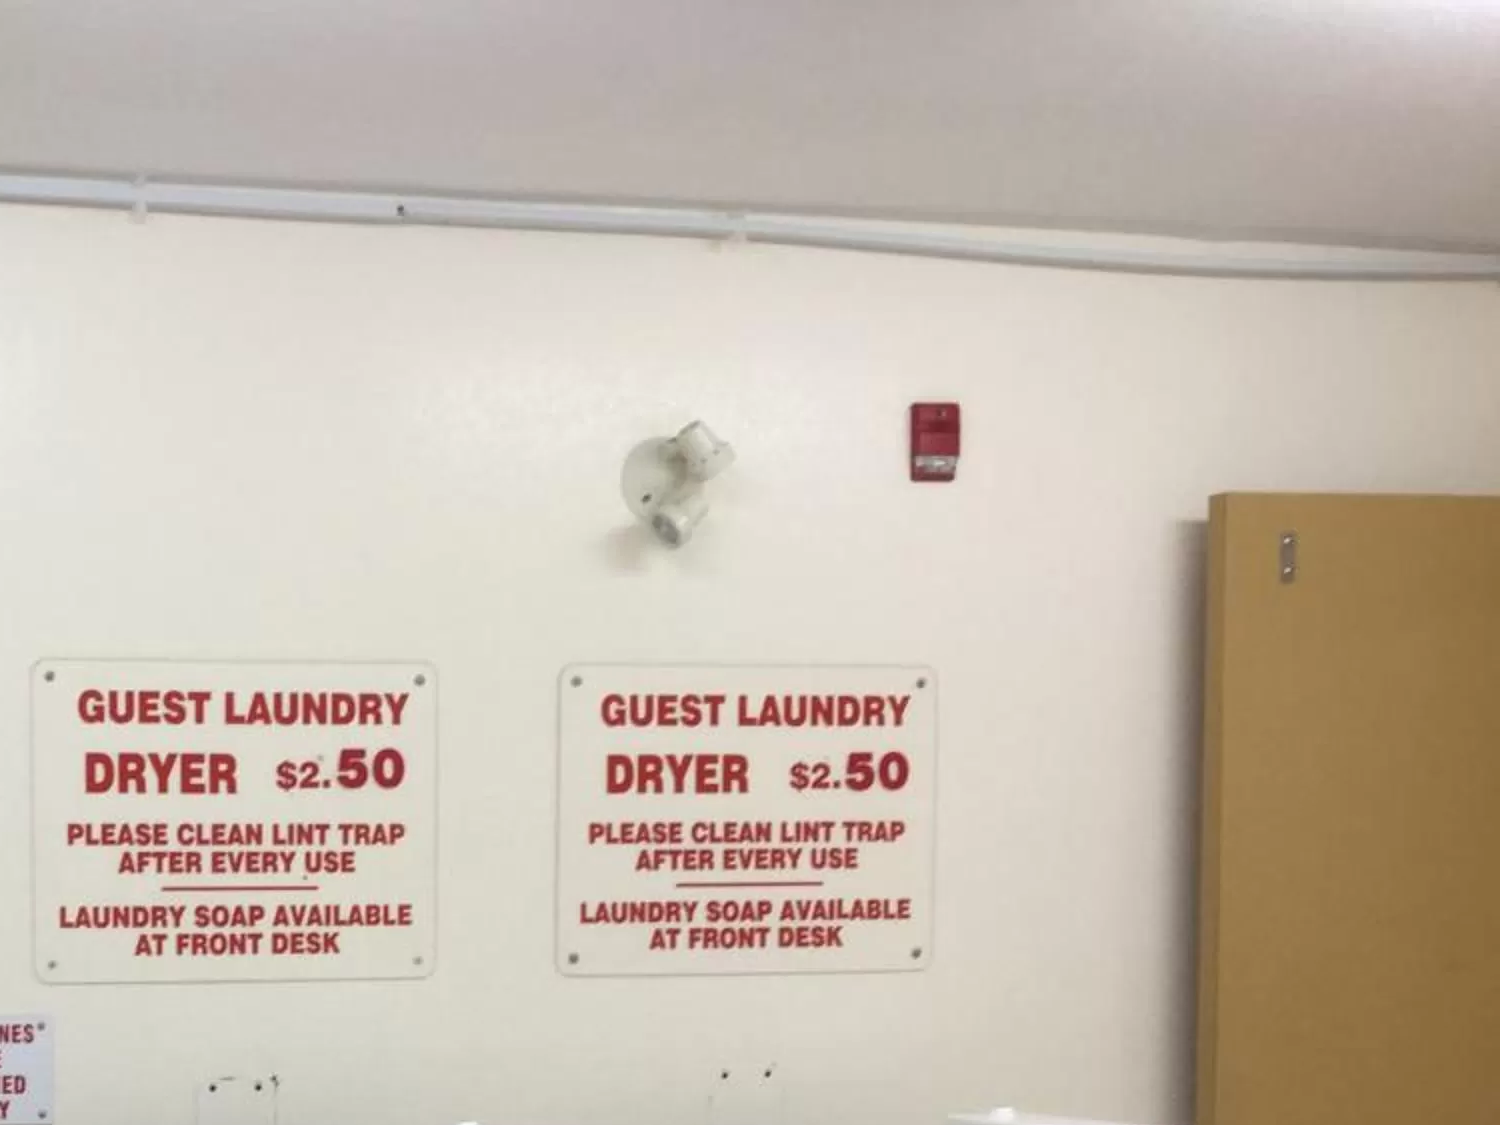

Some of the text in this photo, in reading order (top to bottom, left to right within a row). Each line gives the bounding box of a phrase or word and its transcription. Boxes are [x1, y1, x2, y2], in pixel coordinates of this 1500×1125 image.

[77, 689, 409, 726] GUEST LAUNDRY
[600, 693, 911, 728] GUEST LAUNDRY
[84, 747, 406, 795] DRYER $2.50
[606, 751, 910, 795] DRYER $2.50
[67, 823, 405, 847] PLEASE CLEAN LINT TRAP
[588, 820, 906, 845] PLEASE CLEAN LINT TRAP
[118, 850, 356, 874] AFTER EVERY USE
[635, 847, 859, 871] AFTER EVERY USE
[59, 903, 412, 929] LAUNDRY SOAP AVAILABLE
[579, 898, 911, 925] LAUNDRY SOAP AVAILABLE
[134, 931, 340, 957] AT FRONT DESK
[649, 925, 843, 950] AT FRONT DESK
